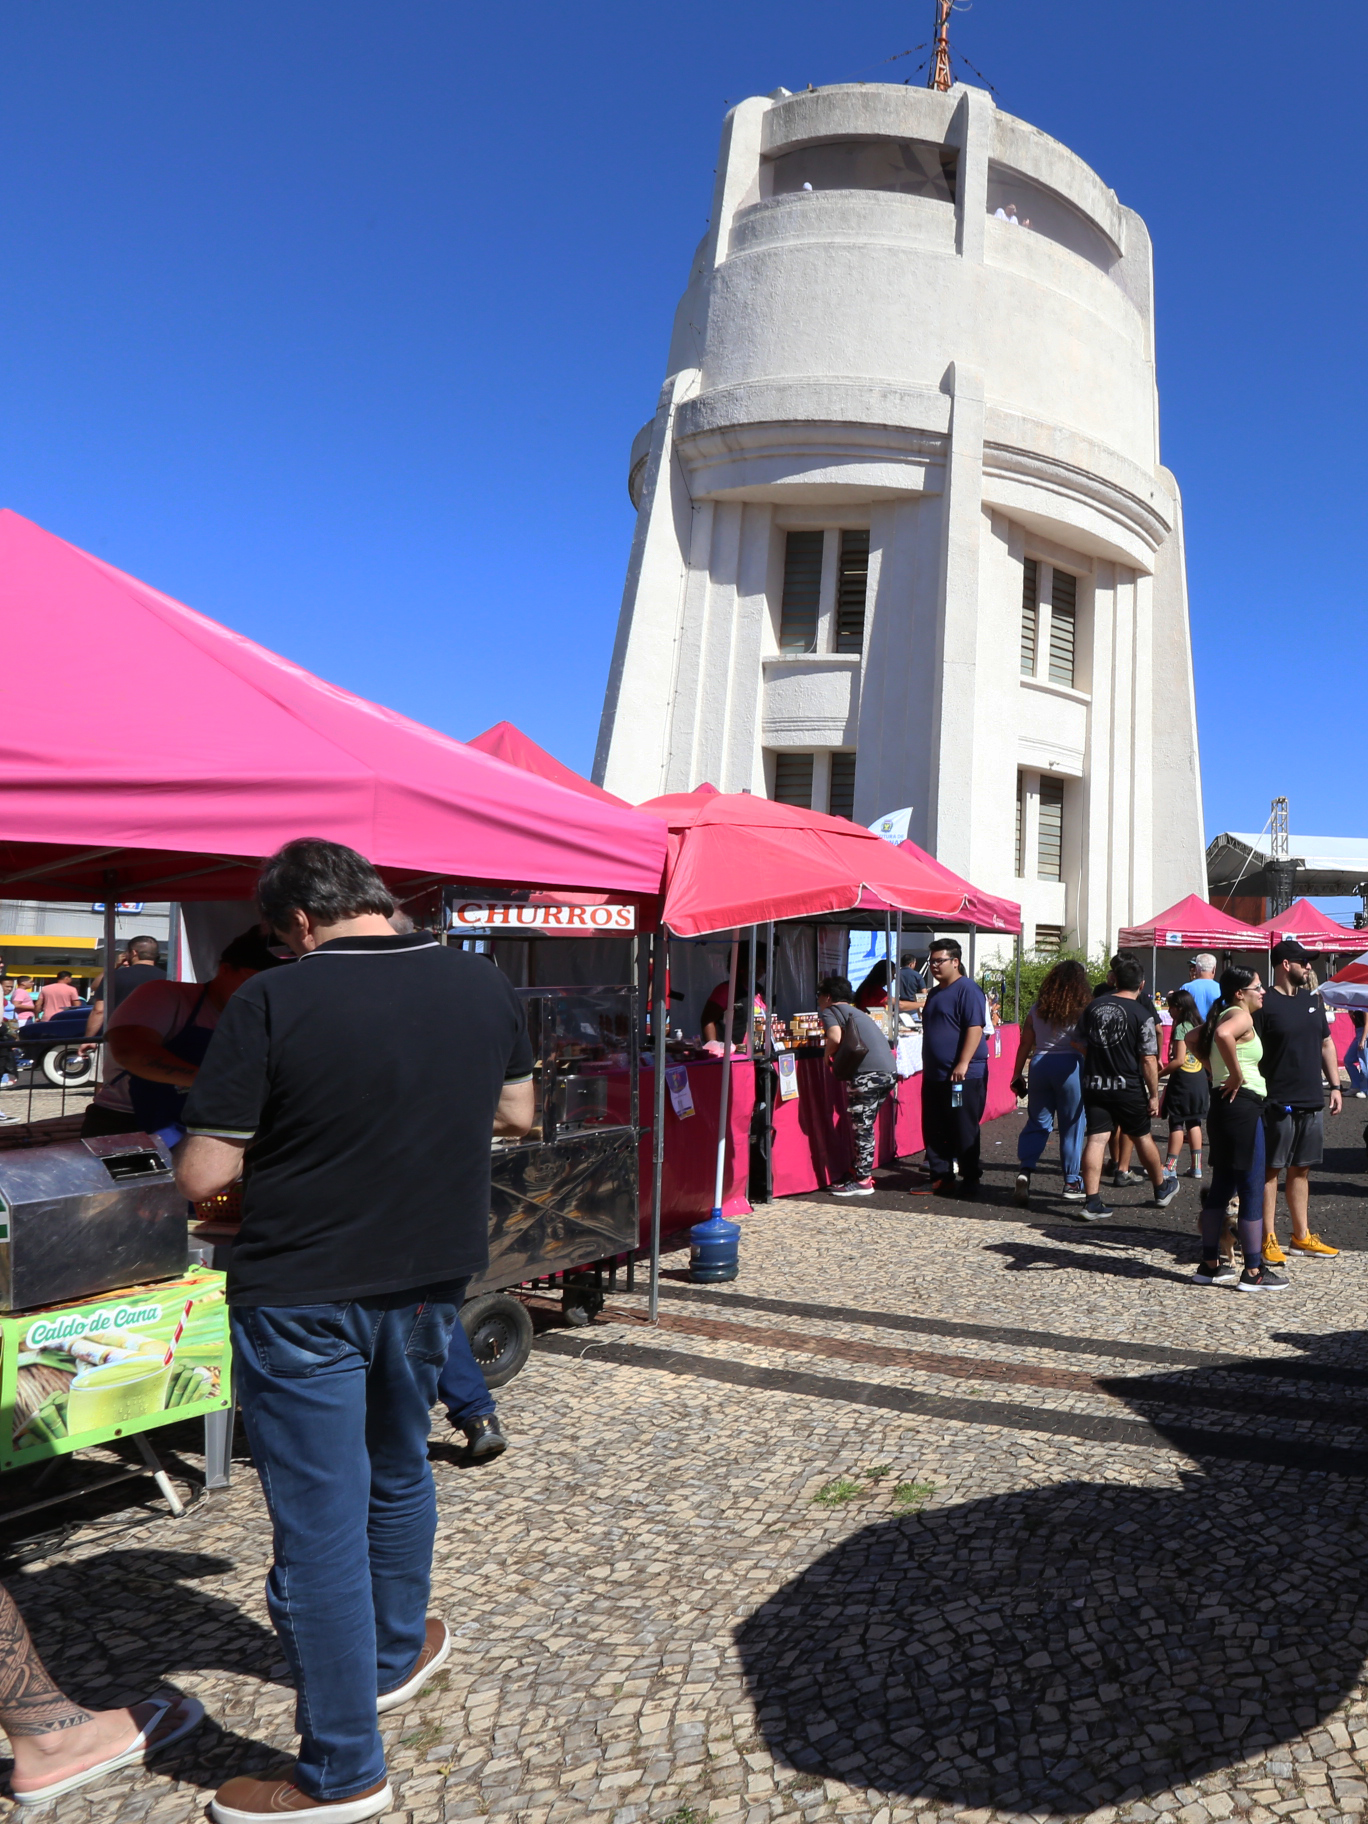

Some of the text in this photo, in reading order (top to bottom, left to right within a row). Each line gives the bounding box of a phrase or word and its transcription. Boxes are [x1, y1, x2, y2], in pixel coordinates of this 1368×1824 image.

[457, 903, 631, 926] CHURROS
[32, 1308, 157, 1344] Caldo de Cana
